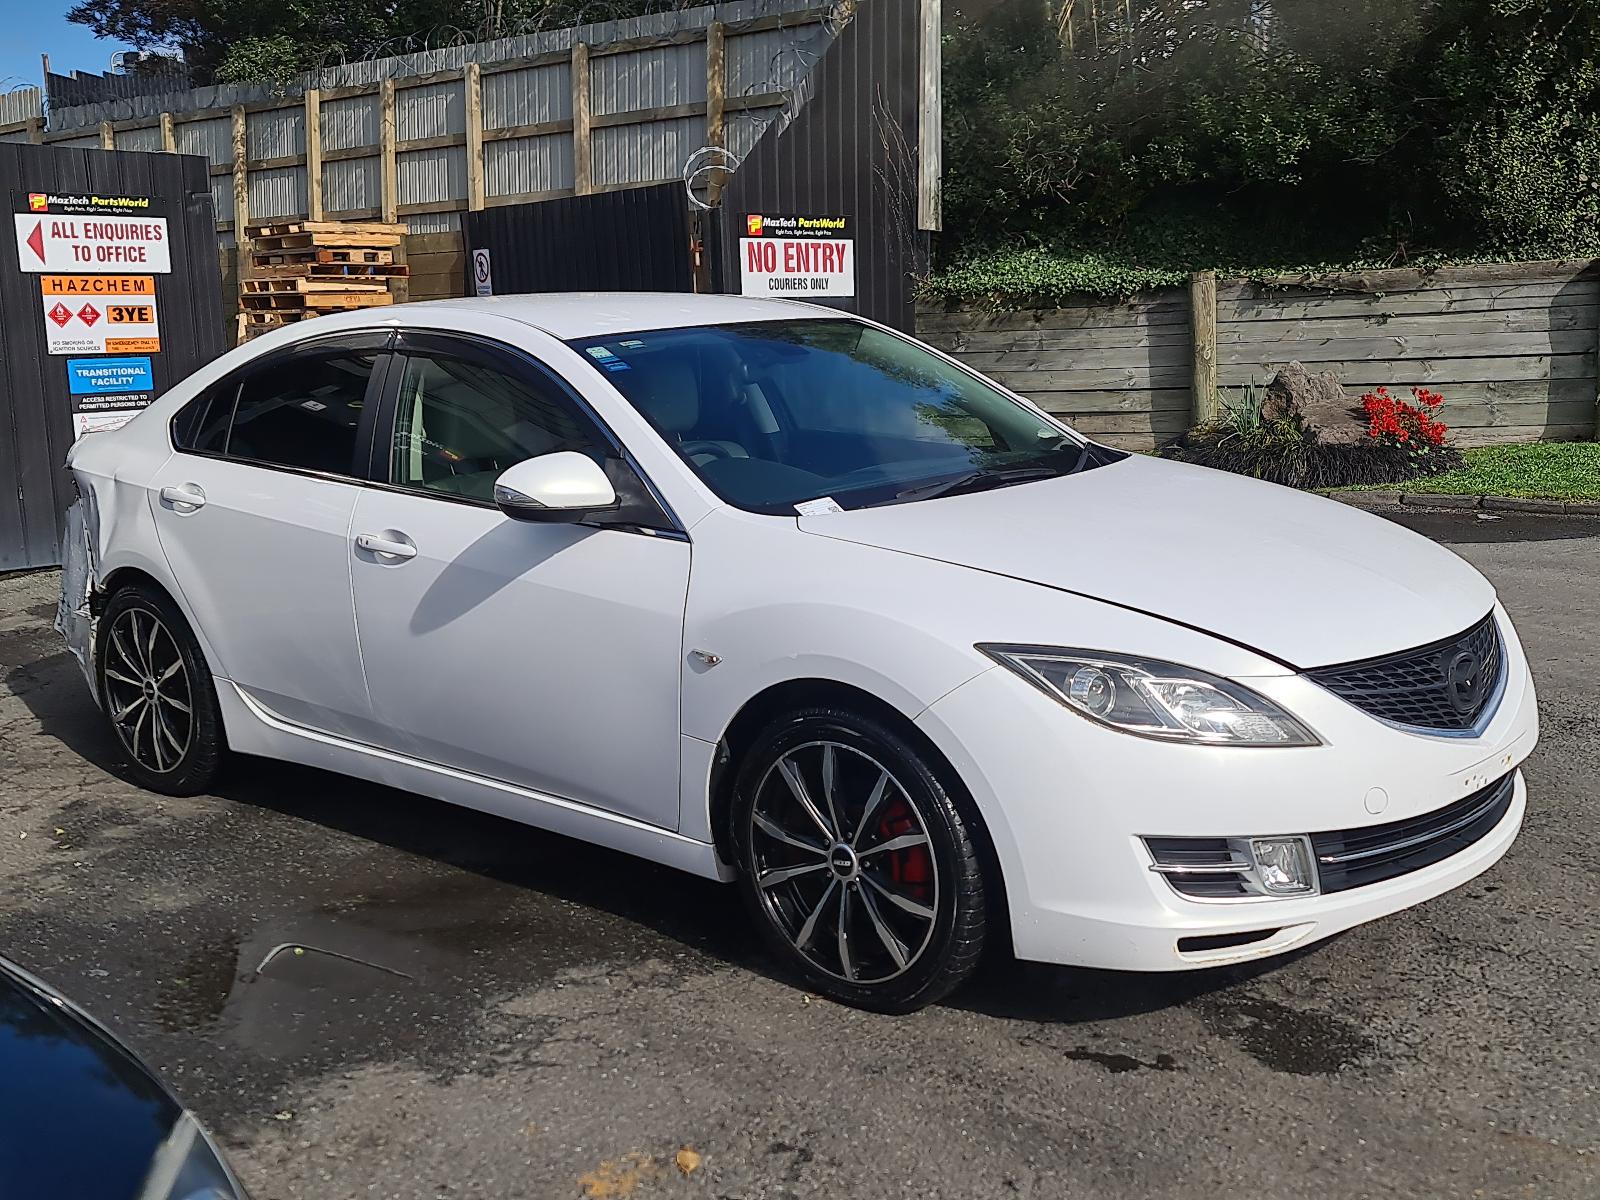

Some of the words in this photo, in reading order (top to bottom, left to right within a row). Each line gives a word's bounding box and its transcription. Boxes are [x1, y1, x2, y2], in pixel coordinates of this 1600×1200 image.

[48, 196, 89, 205] MazTech
[91, 196, 149, 208] PartsWorld
[763, 217, 796, 227] MazTech
[798, 218, 846, 229] PartsWorld
[51, 222, 79, 239] ALL
[84, 222, 162, 241] ENQUIRIES
[72, 245, 91, 262] TO
[96, 246, 147, 262] OFFICE
[748, 242, 776, 273] NO
[784, 242, 846, 273] ENTRY
[52, 279, 145, 292] HAZCHEM
[768, 278, 808, 290] COURIERS
[811, 278, 829, 290] ONLY
[112, 308, 148, 322] 3YE
[76, 368, 146, 376] TRANSITIONAL
[92, 377, 134, 386] FACILITY
